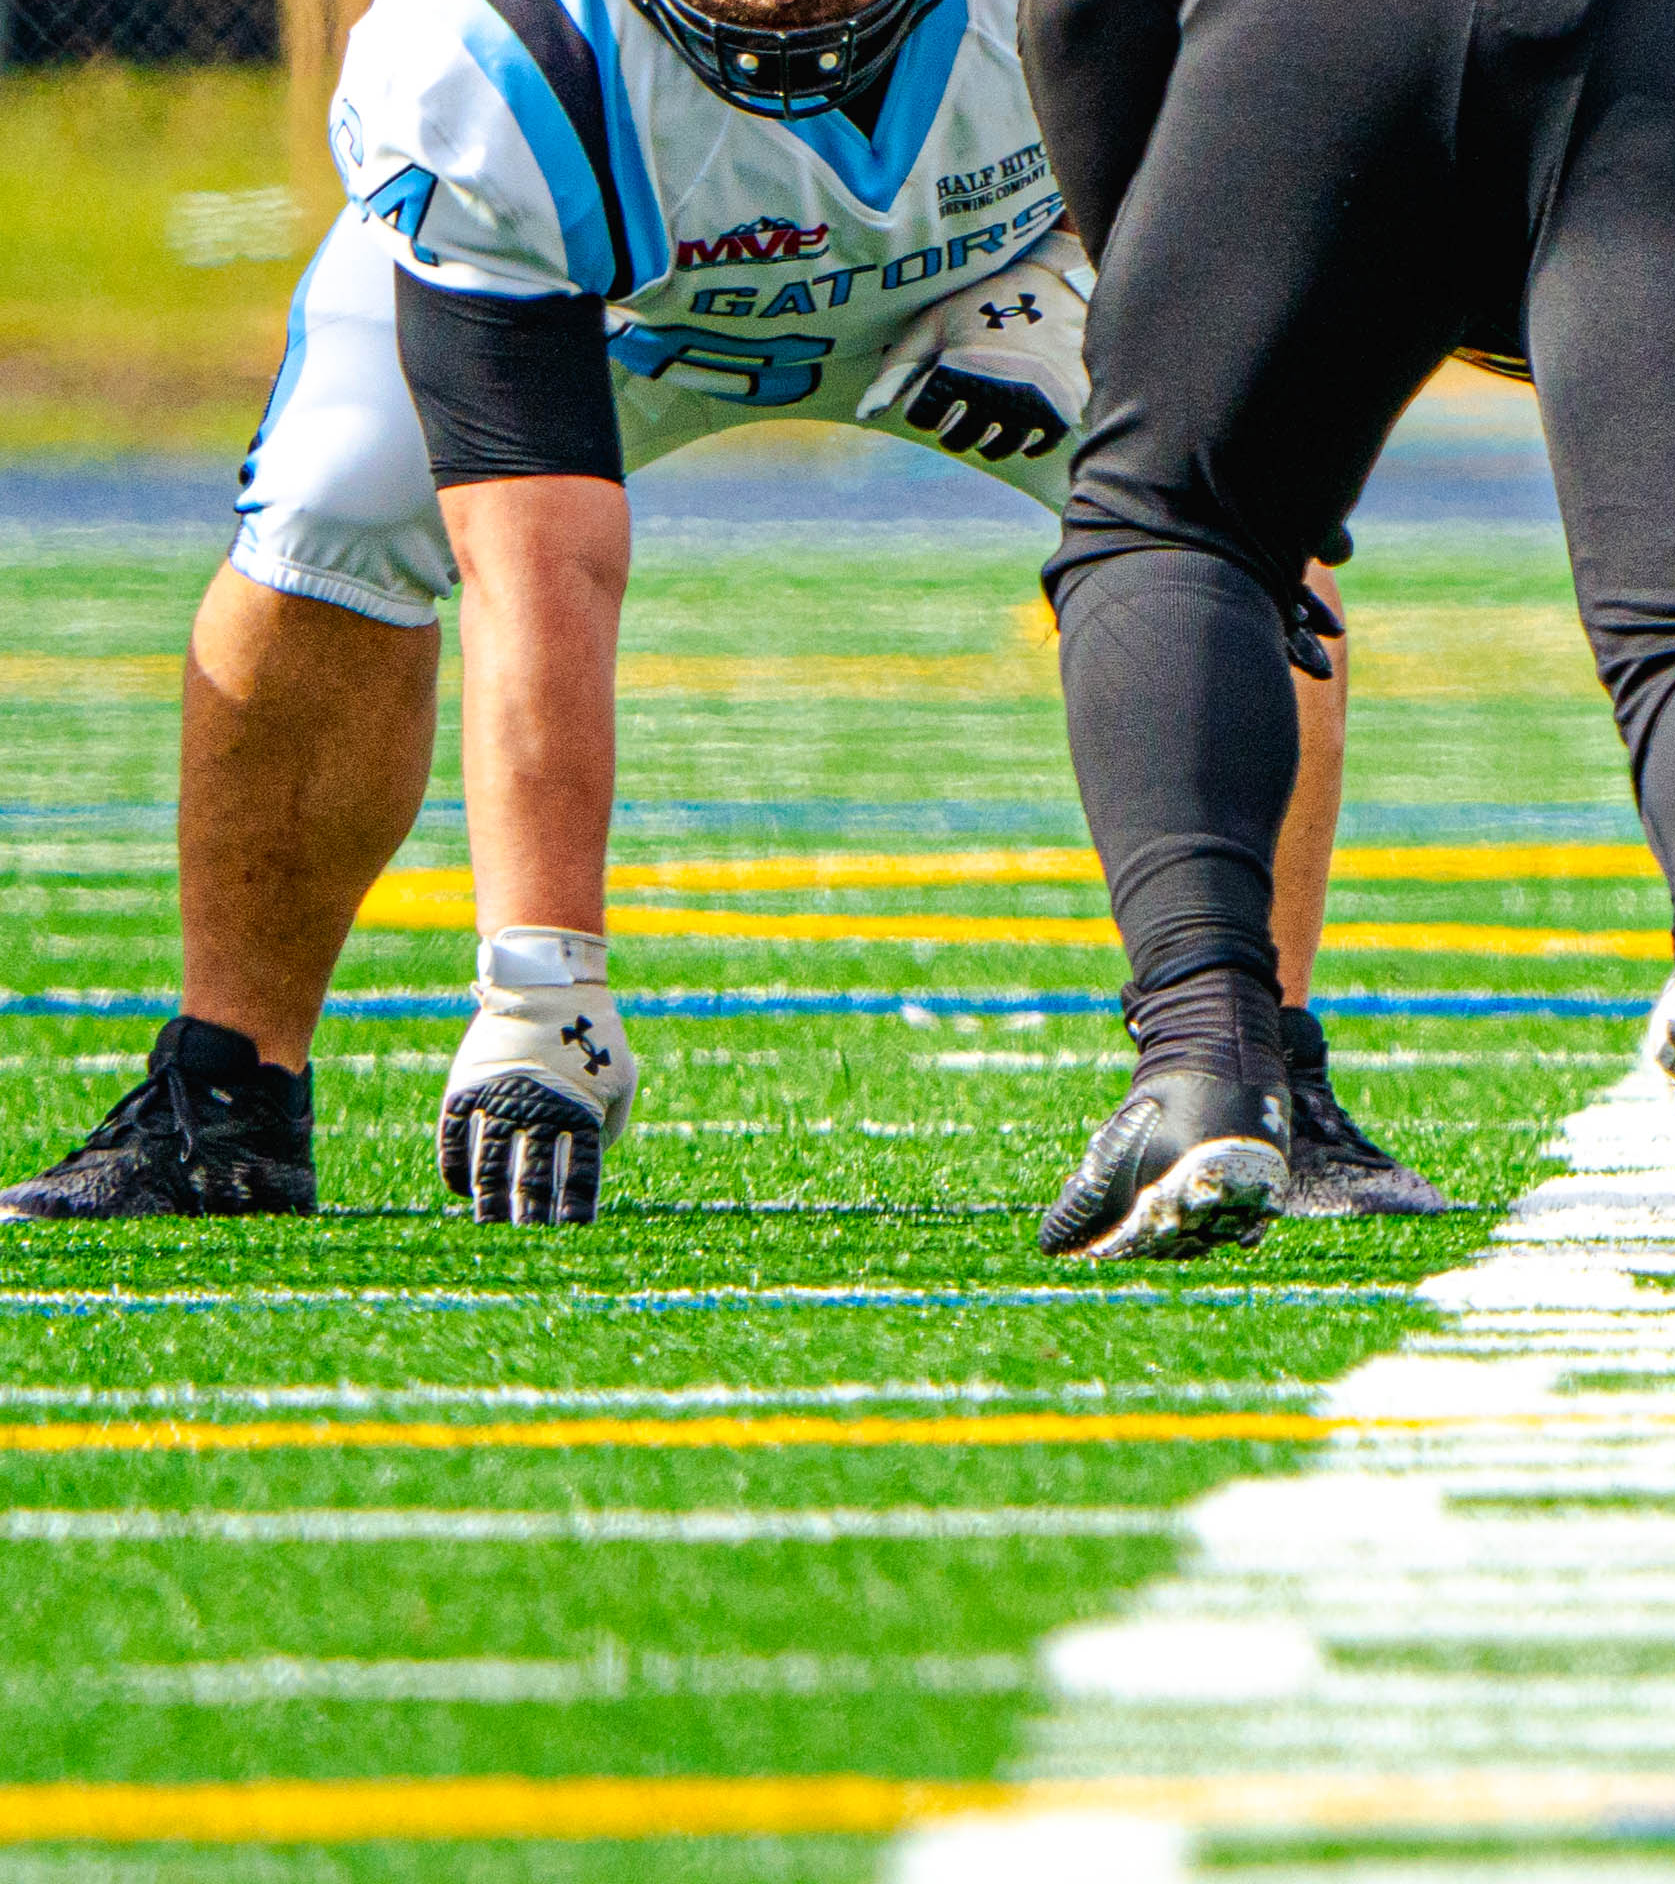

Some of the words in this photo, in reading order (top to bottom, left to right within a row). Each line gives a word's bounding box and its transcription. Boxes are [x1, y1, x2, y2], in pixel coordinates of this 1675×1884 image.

[937, 163, 995, 200] HALF
[677, 222, 830, 267] MVP
[689, 190, 1064, 318] GATORS
